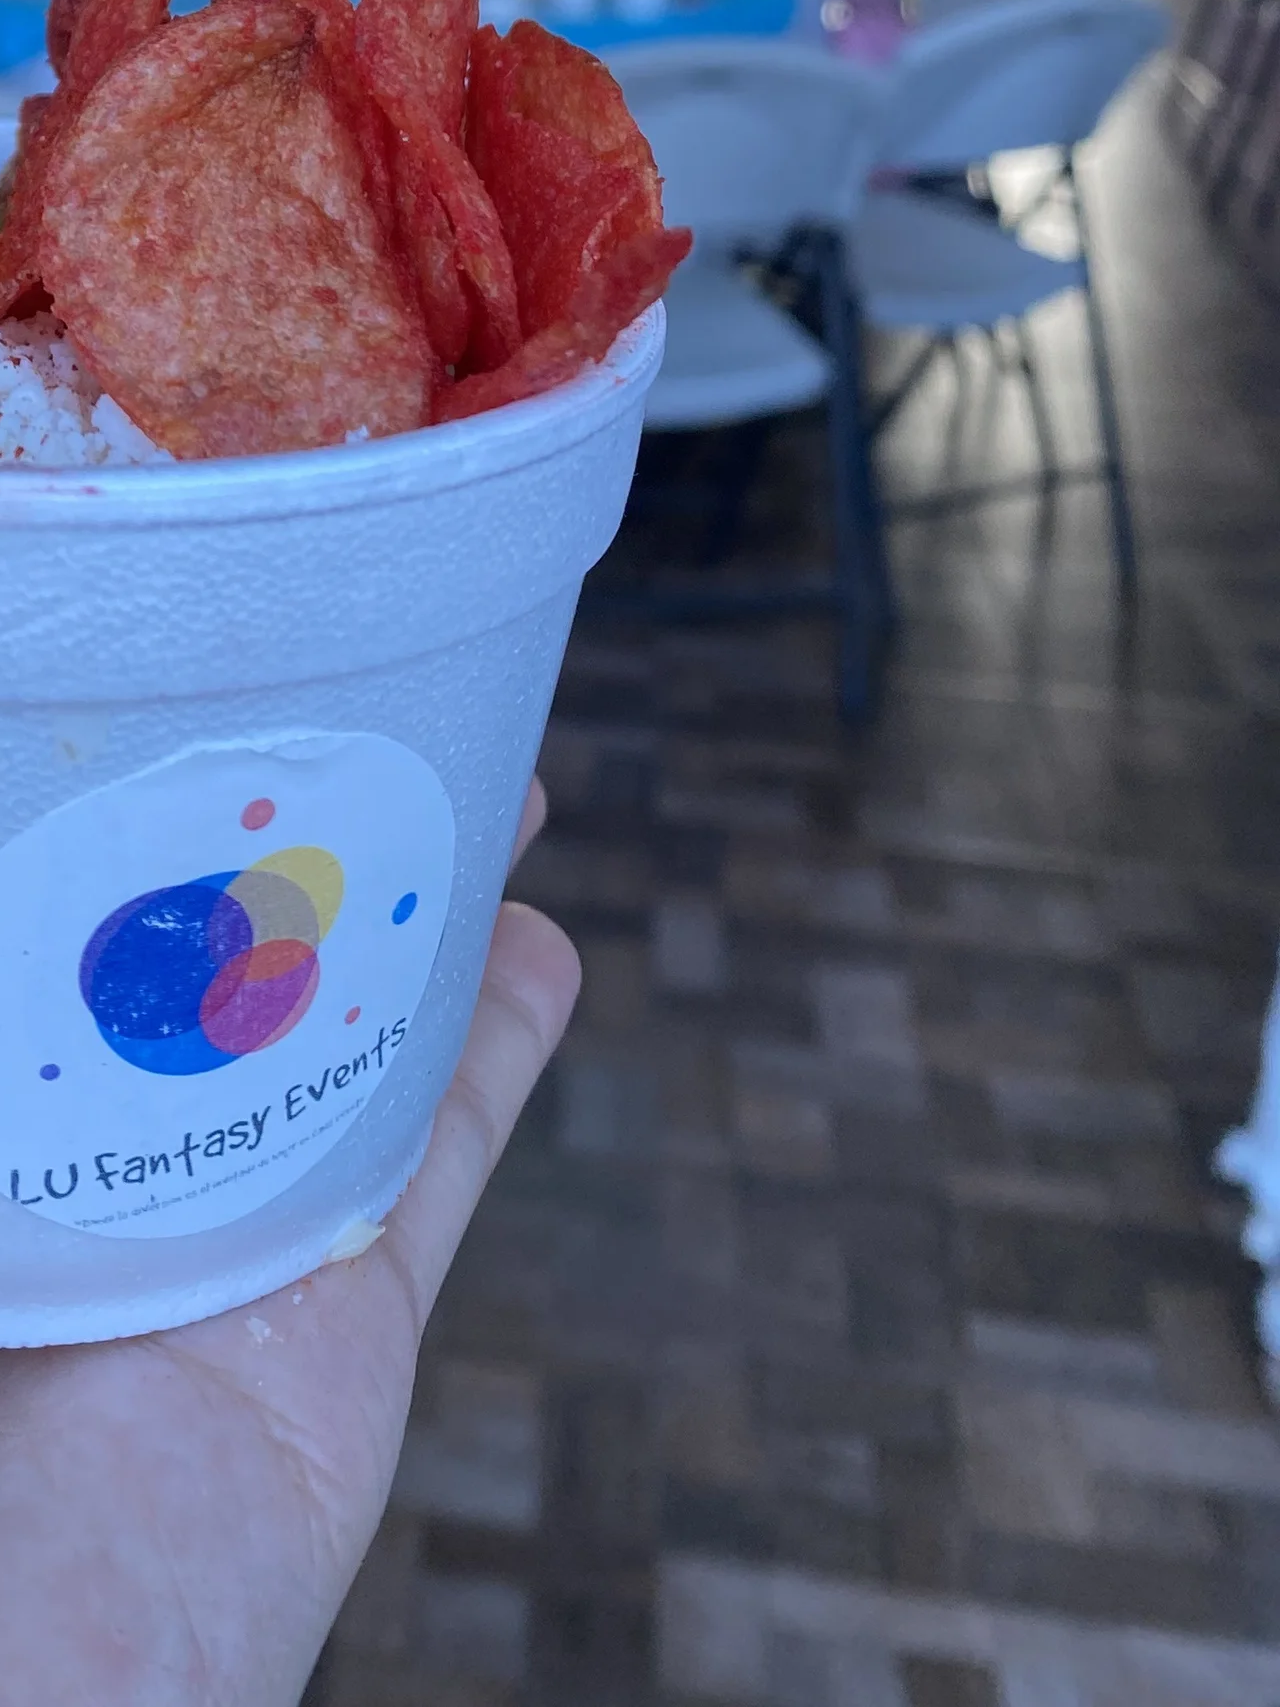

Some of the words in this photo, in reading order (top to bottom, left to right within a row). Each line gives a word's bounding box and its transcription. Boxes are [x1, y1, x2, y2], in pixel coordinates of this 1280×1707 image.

[10, 1162, 79, 1205] LU
[93, 1105, 272, 1191] Fantasy
[284, 1017, 408, 1122] Events
